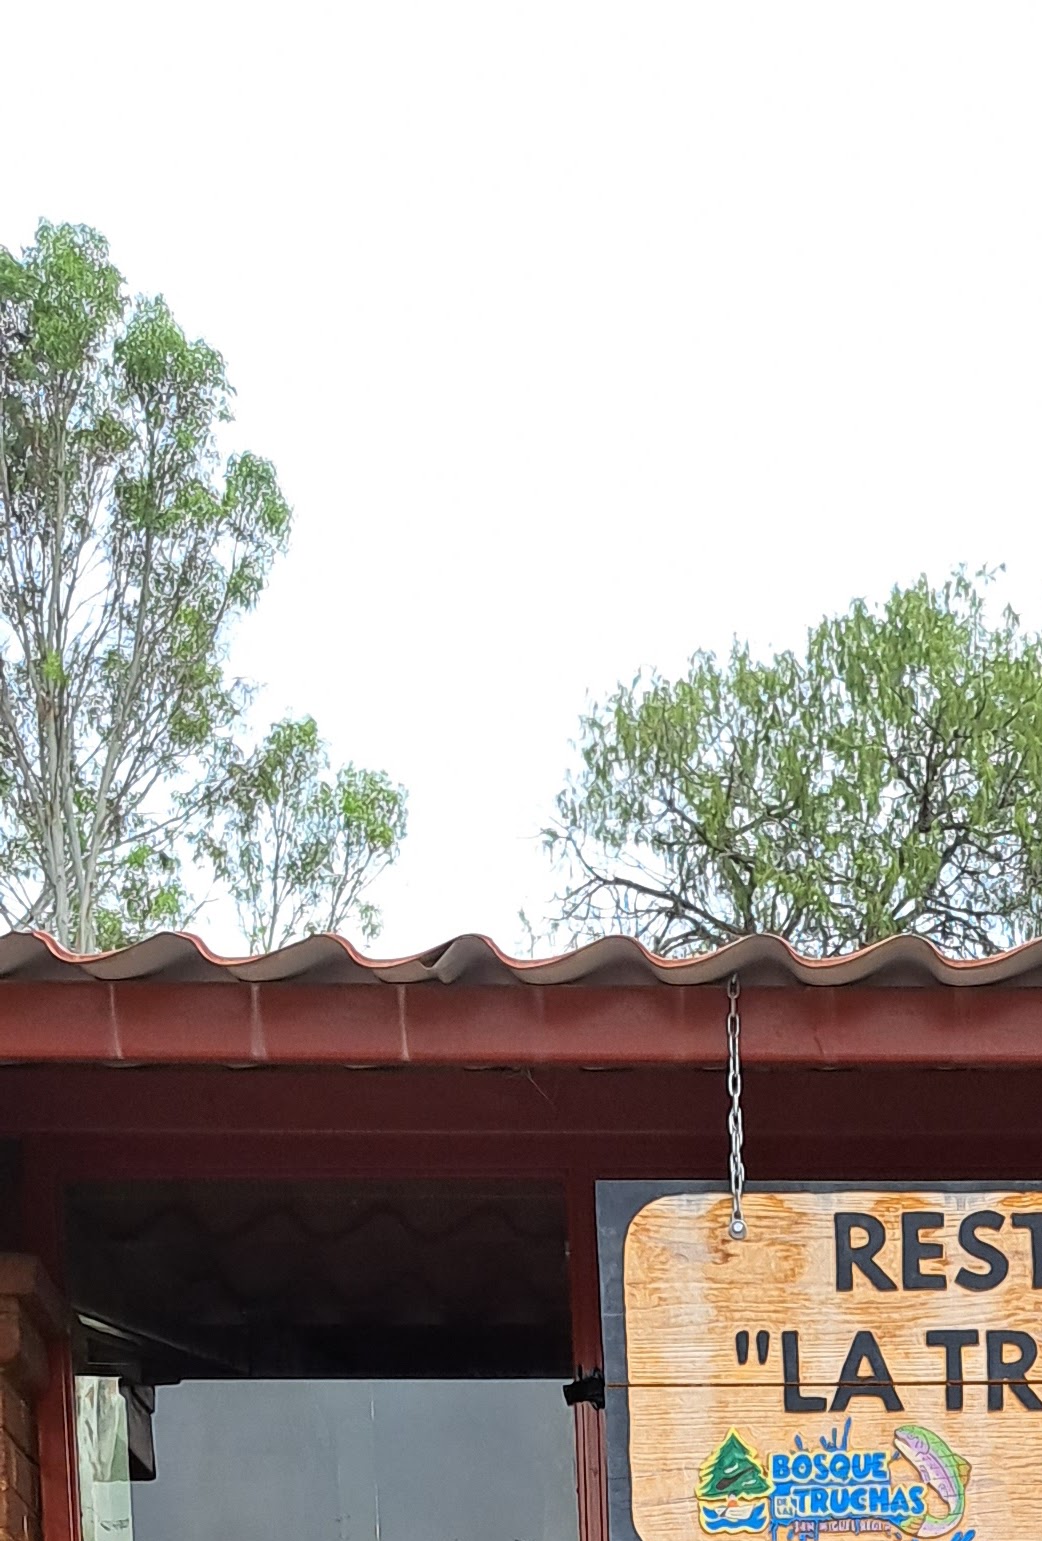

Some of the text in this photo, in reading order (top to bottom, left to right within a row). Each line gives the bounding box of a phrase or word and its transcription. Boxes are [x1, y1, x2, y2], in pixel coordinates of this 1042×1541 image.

[735, 1330, 905, 1413] "LA
[772, 1452, 888, 1482] BOSQUE
[792, 1486, 925, 1515] TRUCHAS
